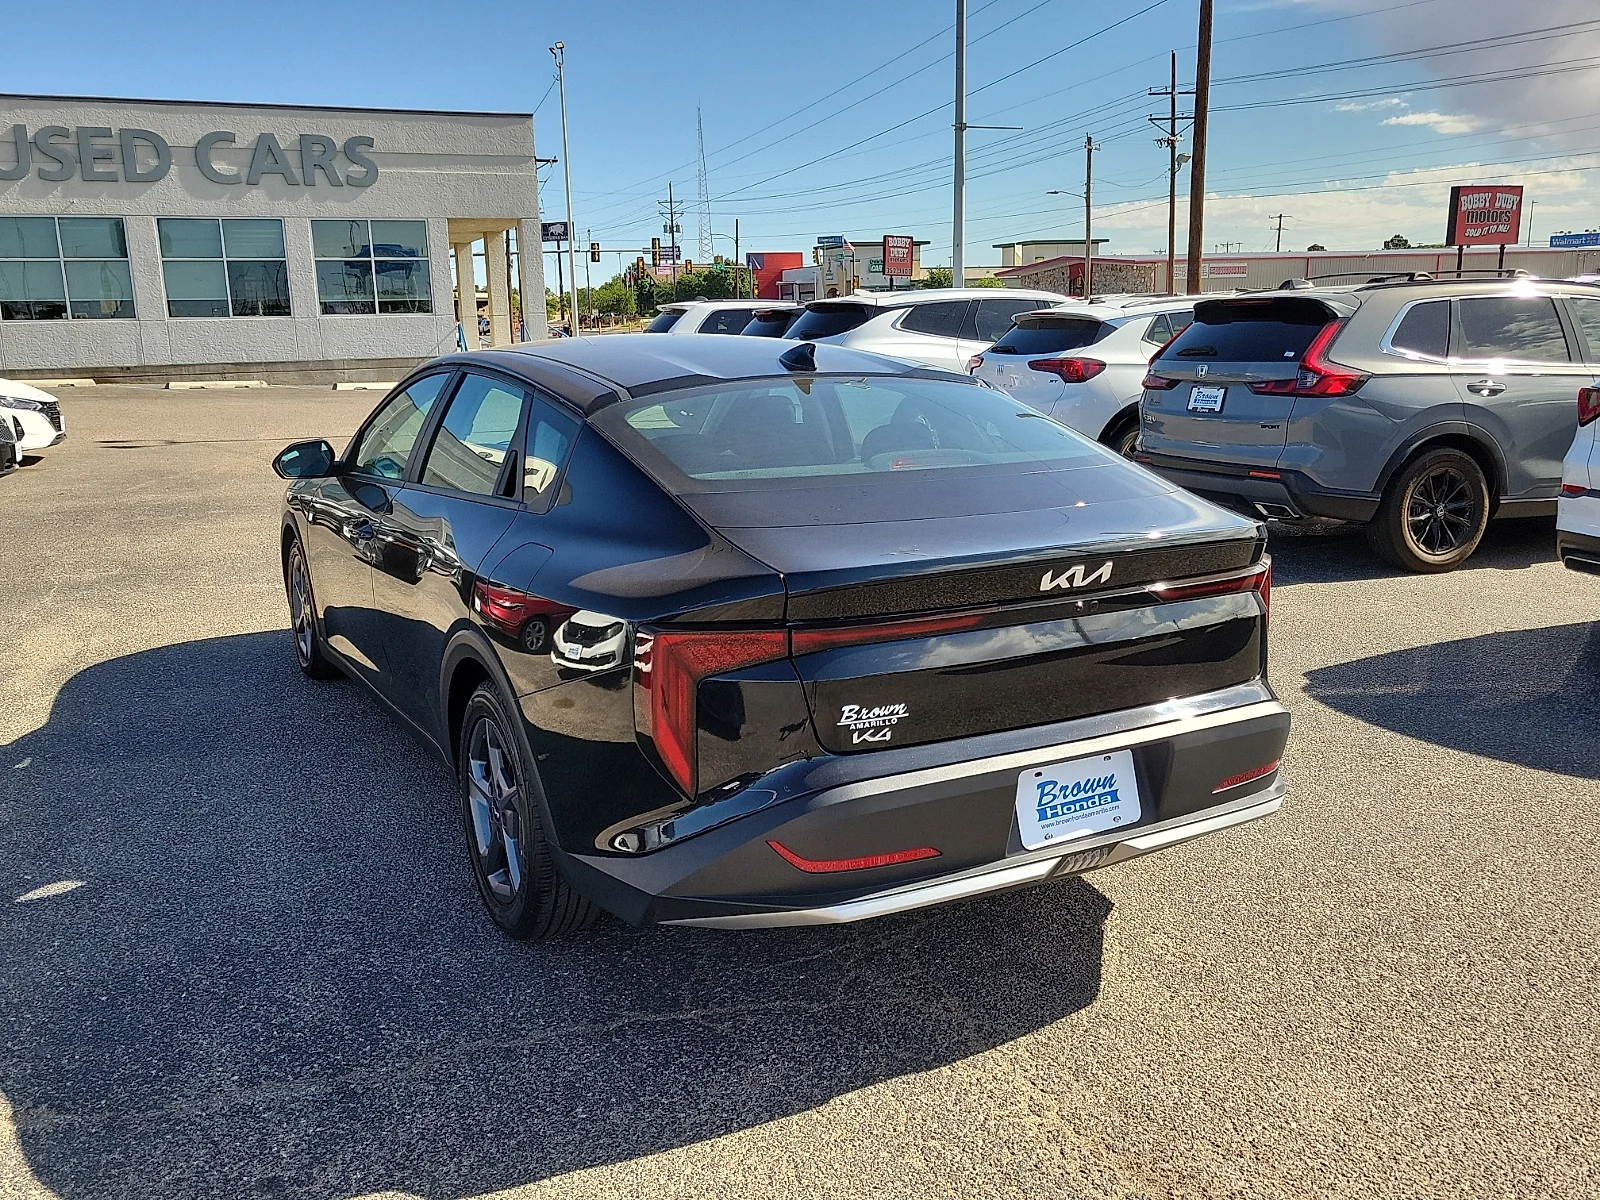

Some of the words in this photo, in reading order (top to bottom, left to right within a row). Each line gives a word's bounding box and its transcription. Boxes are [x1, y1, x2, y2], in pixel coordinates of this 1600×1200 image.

[195, 130, 379, 187] CARS
[1461, 193, 1491, 212] BOBBY
[1495, 193, 1520, 211] DUBY
[1466, 209, 1511, 223] motors
[1465, 228, 1481, 237] SOLD
[1552, 234, 1586, 245] Walmart
[1040, 561, 1113, 591] KIA
[840, 703, 907, 723] Brown
[849, 717, 898, 731] AMARILLO
[852, 727, 892, 745] K4
[1037, 773, 1117, 808] Brown
[1045, 794, 1112, 818] Honda
